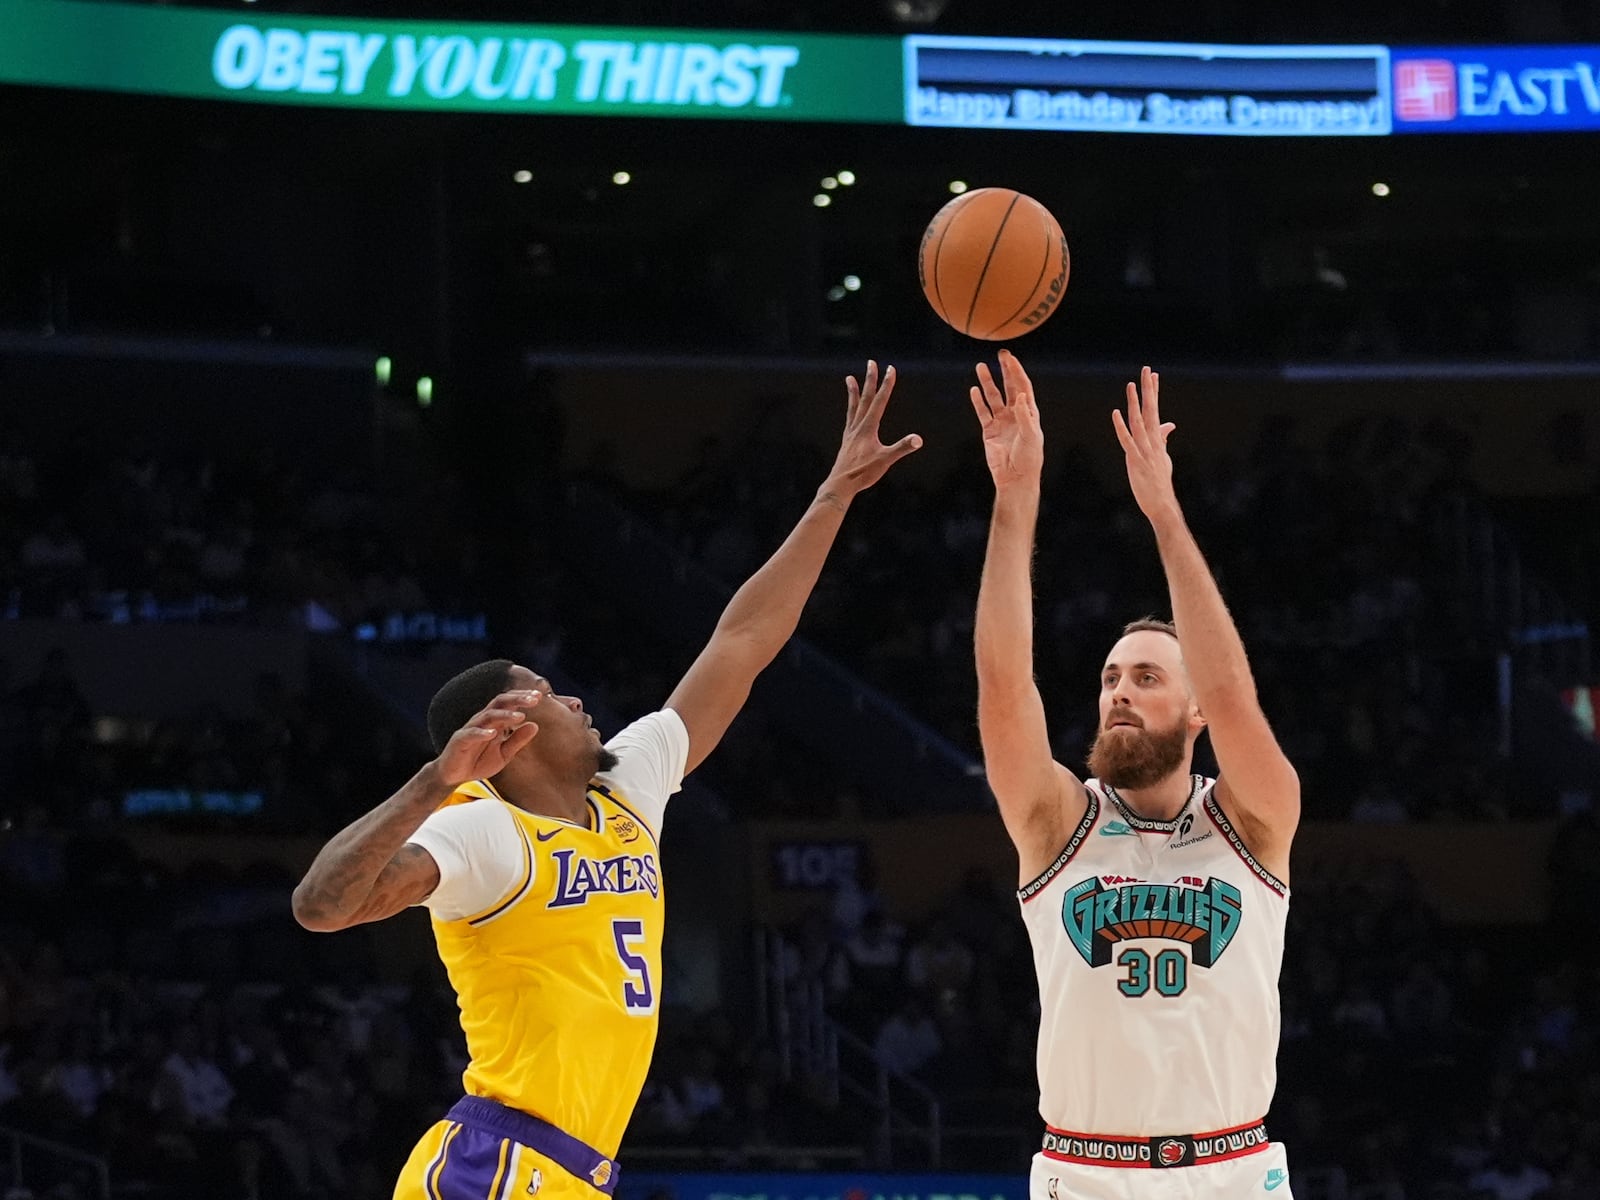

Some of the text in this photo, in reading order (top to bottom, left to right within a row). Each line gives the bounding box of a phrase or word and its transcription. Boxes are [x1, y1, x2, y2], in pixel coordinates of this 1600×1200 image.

[213, 24, 798, 107] OBEY YOUR THIRST
[918, 86, 1010, 126] Happy
[1013, 88, 1143, 127] Birthday
[1145, 92, 1227, 124] Scott
[1169, 830, 1213, 850] Robinhood
[546, 848, 660, 909] LAKERS
[1061, 875, 1243, 969] GRIZZLIES
[611, 917, 656, 1017] 5
[1116, 947, 1188, 998] 30
